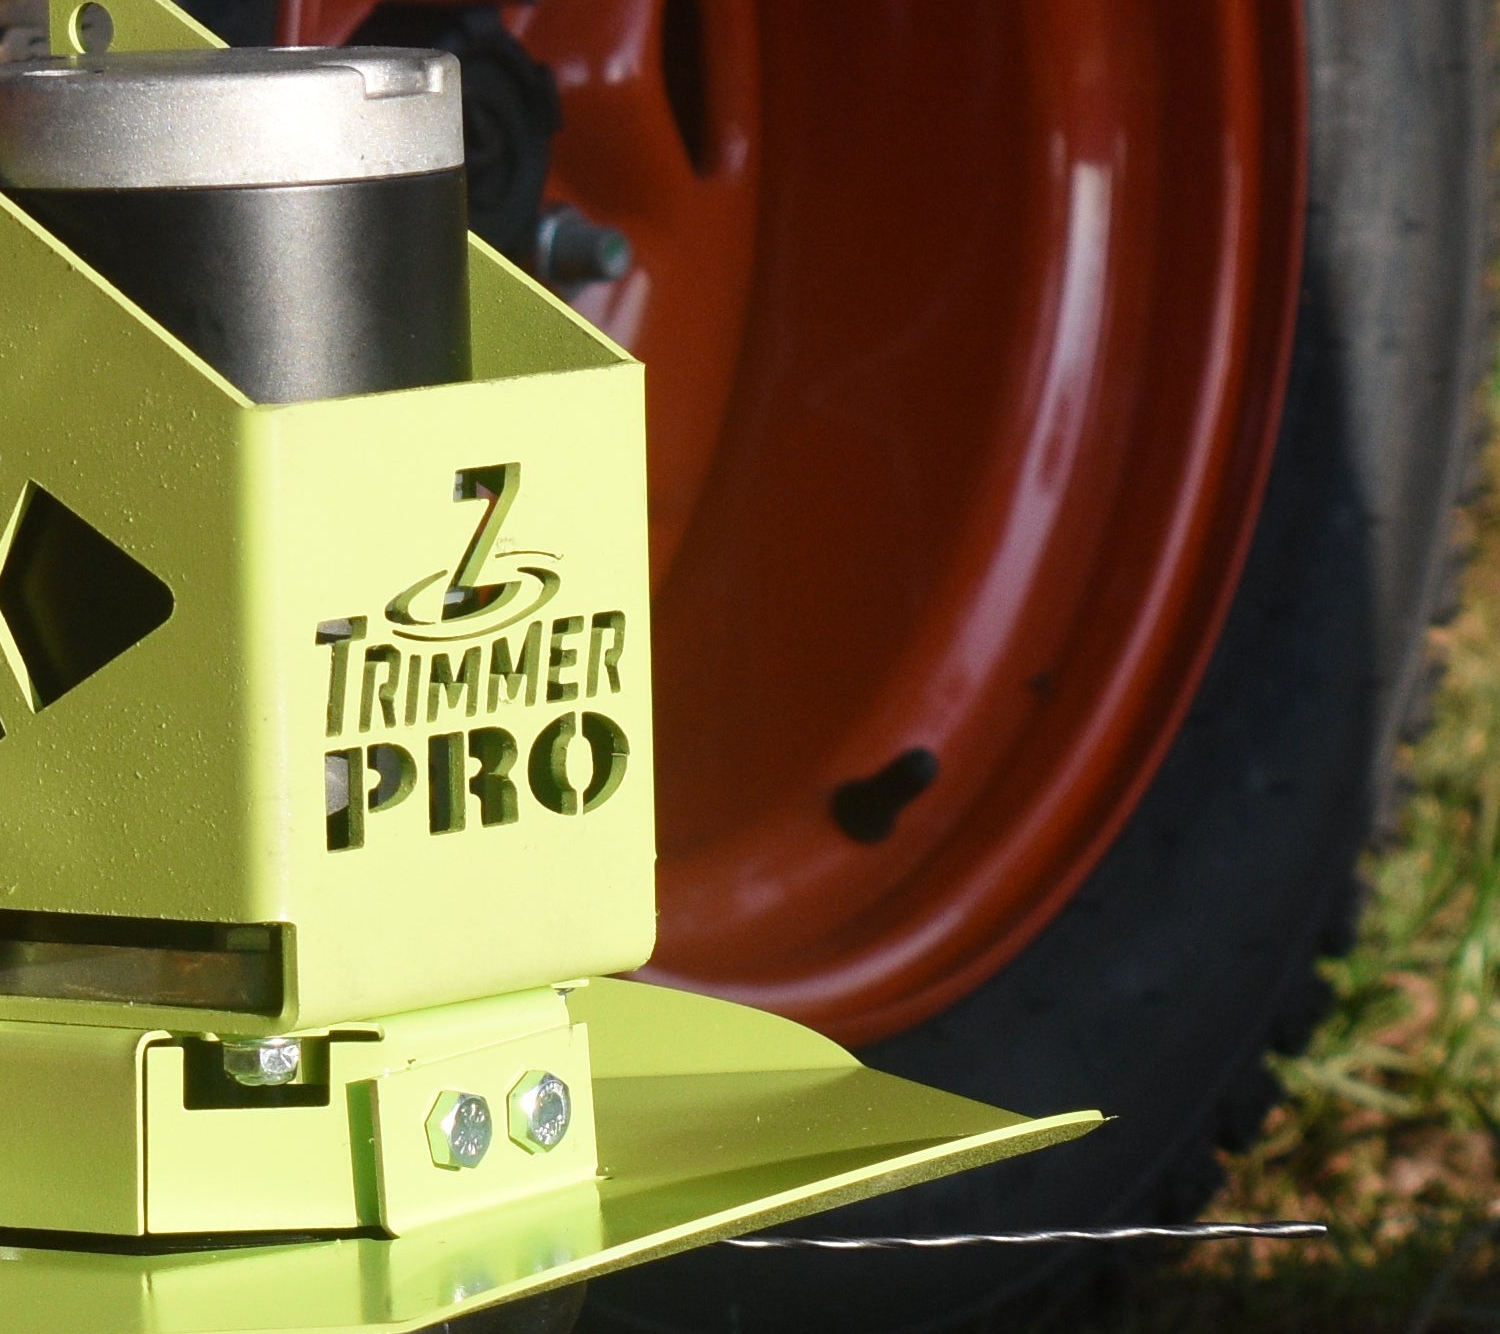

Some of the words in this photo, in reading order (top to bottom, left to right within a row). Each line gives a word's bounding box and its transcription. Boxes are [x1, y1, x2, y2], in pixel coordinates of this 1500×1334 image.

[441, 462, 522, 623] Z
[315, 610, 626, 737] TRIMMER
[324, 711, 631, 854] PRO
